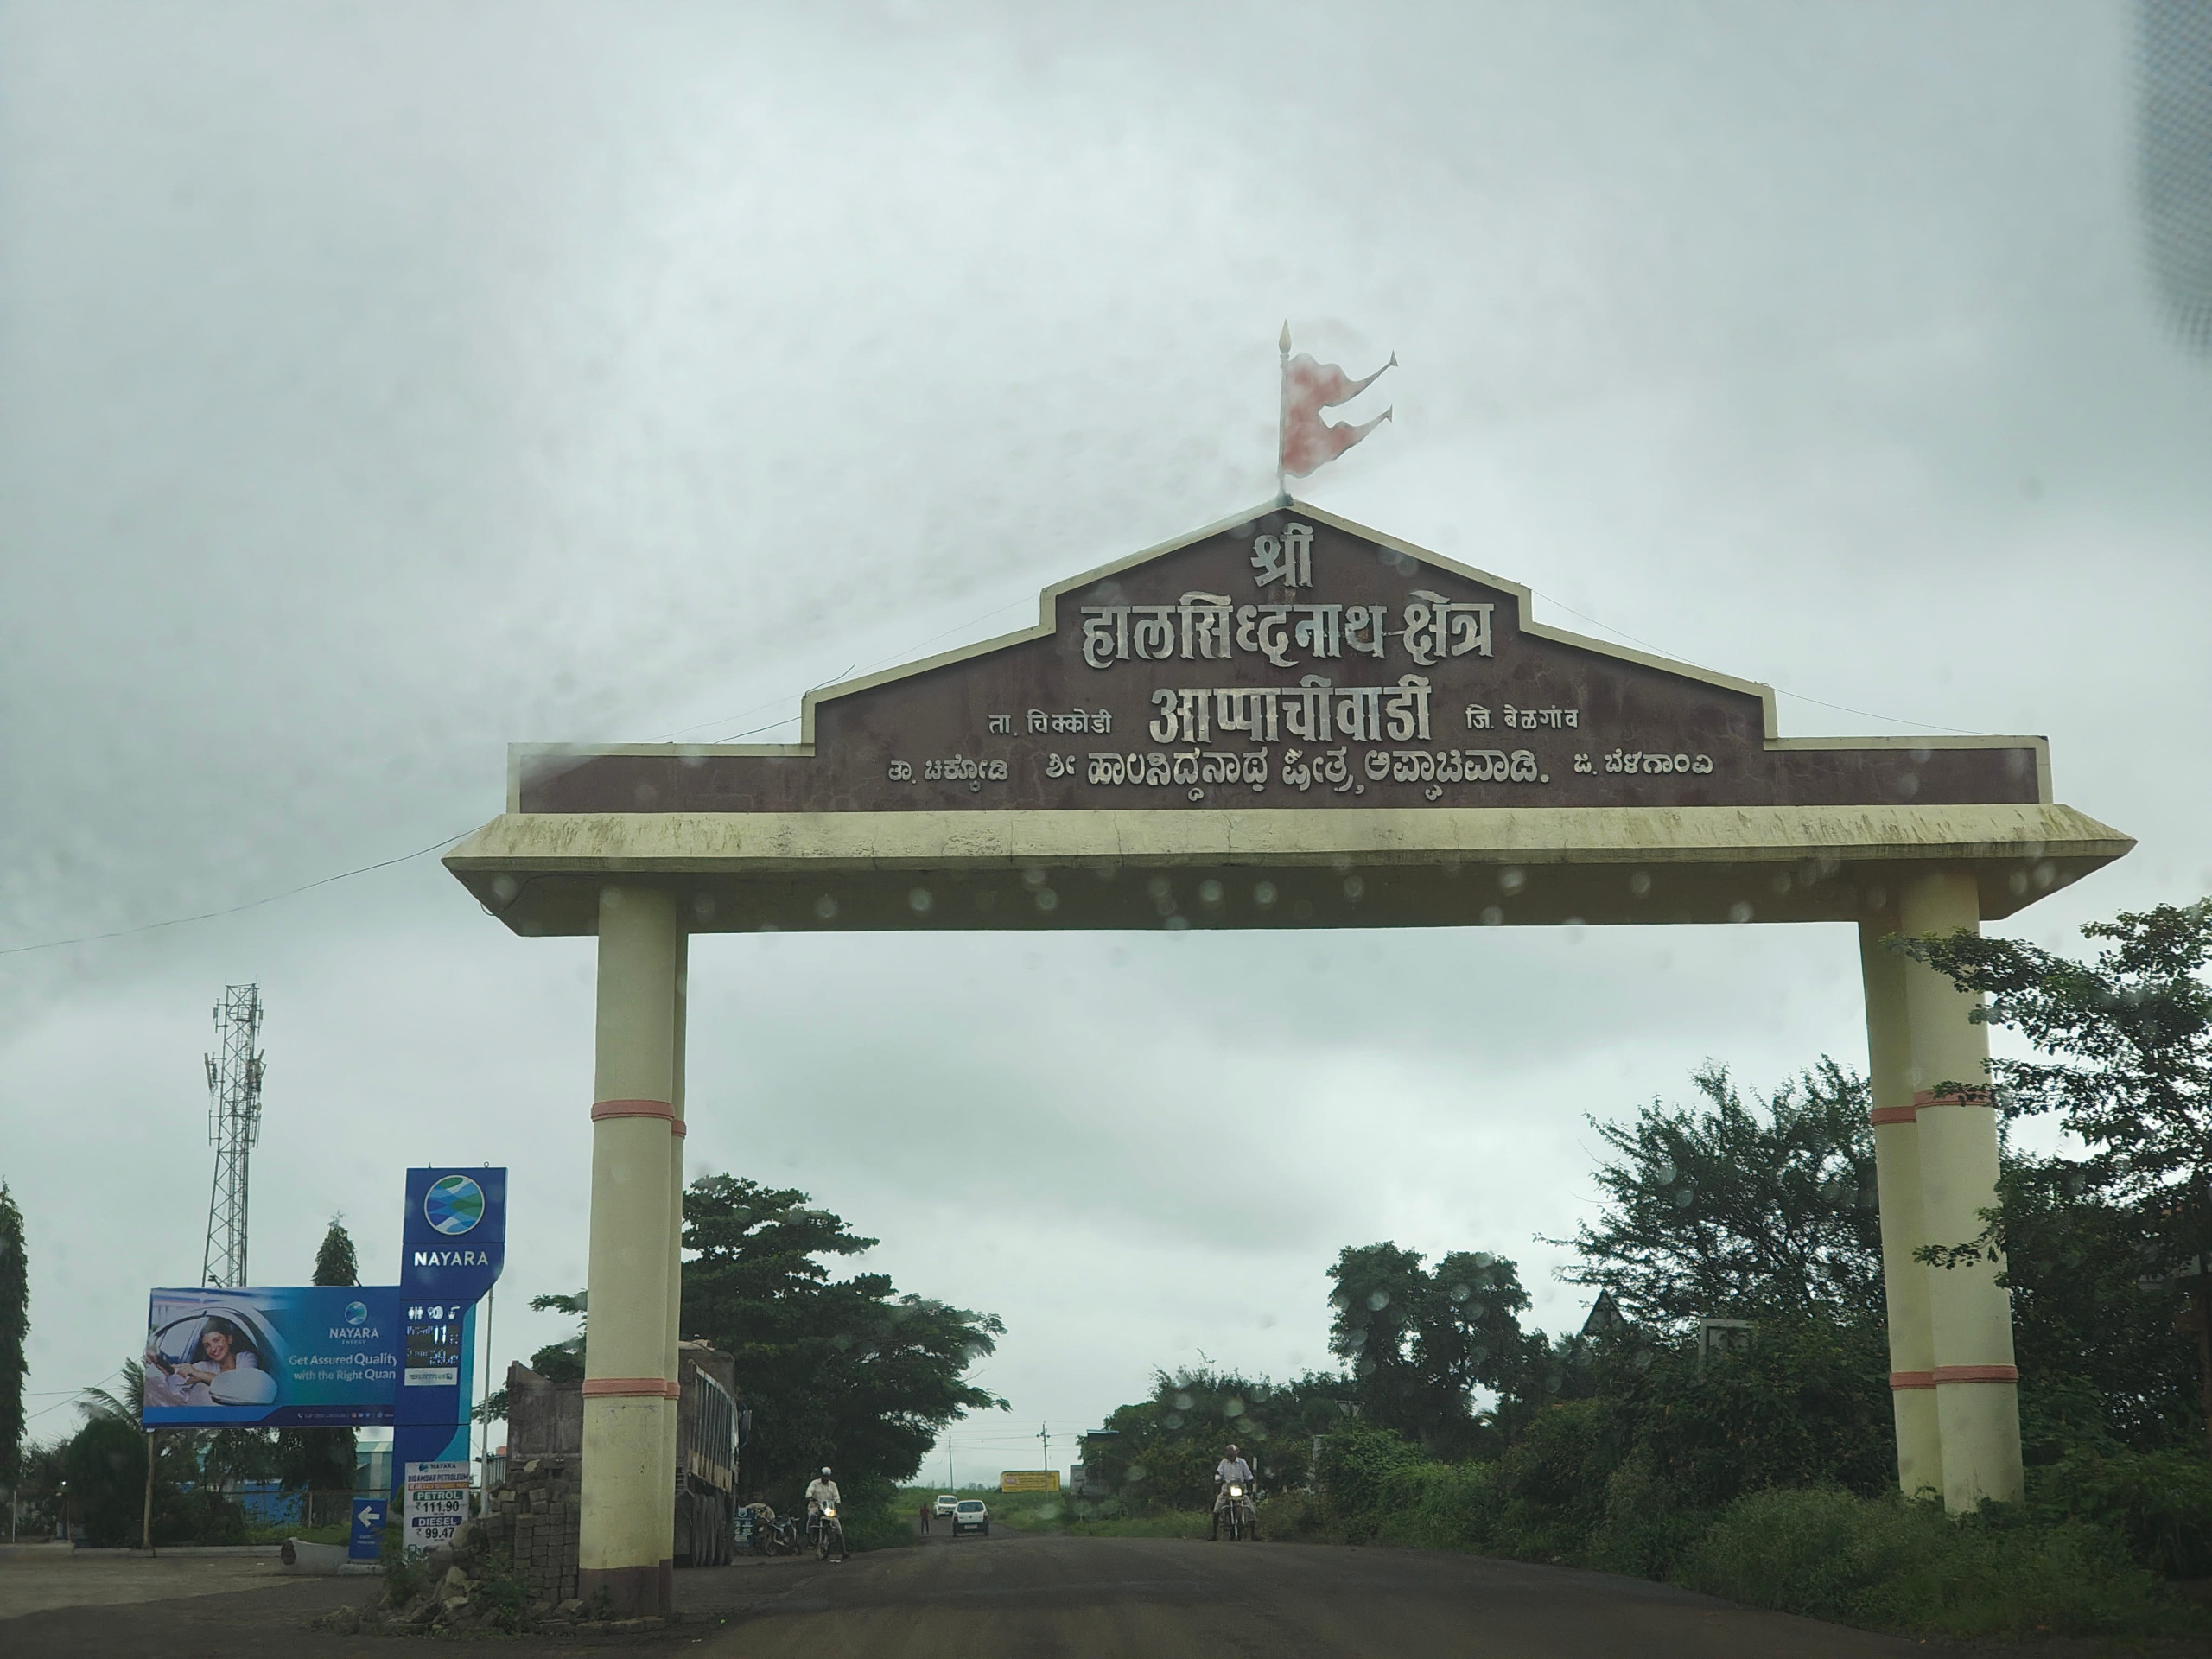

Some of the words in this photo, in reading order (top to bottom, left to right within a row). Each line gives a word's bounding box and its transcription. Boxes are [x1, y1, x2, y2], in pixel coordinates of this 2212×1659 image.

[1249, 522, 1314, 588] श्री
[1402, 589, 1495, 666] क्षेत्र
[1026, 708, 1113, 734] चिक्कोडी
[1149, 673, 1433, 744] आप्पाचीवाडी
[1503, 703, 1579, 730] बेळगांव
[414, 1250, 489, 1267] NAYARA
[329, 1327, 379, 1338] NAYARA
[289, 1355, 308, 1365] Get
[310, 1354, 353, 1365] Assured
[294, 1370, 316, 1381] with
[318, 1370, 334, 1380] the
[336, 1370, 363, 1382] Right
[437, 1473, 468, 1482] PETROLEUM
[417, 1491, 461, 1501] PETROL
[423, 1501, 460, 1512] 111.90
[418, 1517, 457, 1526] DIESEL
[425, 1527, 455, 1539] 99.47
